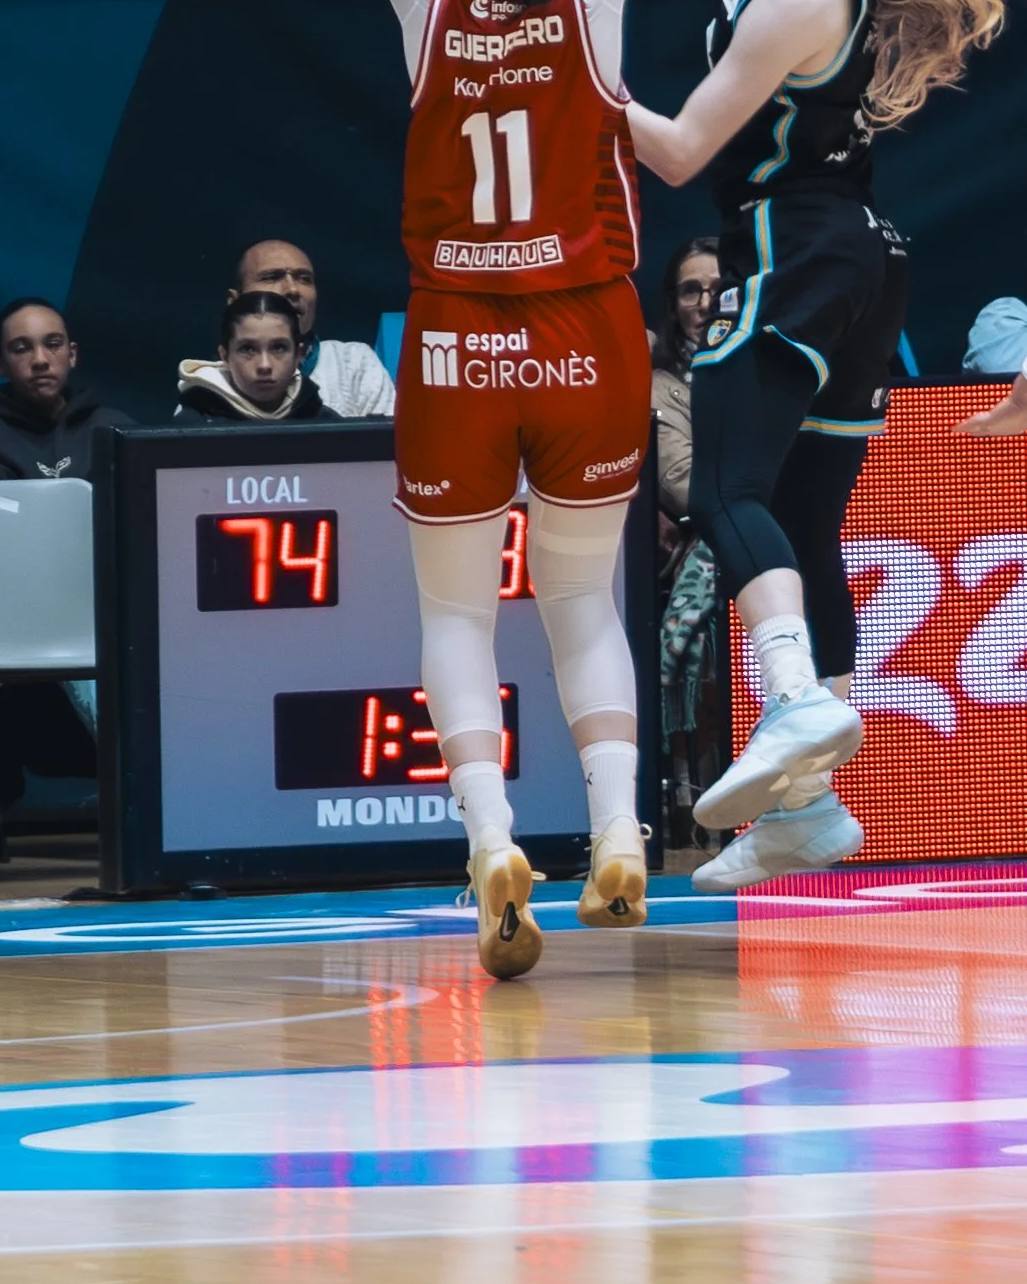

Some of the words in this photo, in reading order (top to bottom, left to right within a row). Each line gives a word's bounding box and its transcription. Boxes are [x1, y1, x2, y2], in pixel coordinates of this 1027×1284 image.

[461, 109, 533, 224] 11
[437, 239, 559, 267] BAUHAUS
[464, 328, 528, 356] espai
[464, 350, 598, 388] GIRONÈS
[583, 447, 639, 482] ginvest
[226, 475, 308, 504] LOCAL
[220, 518, 331, 602] 74
